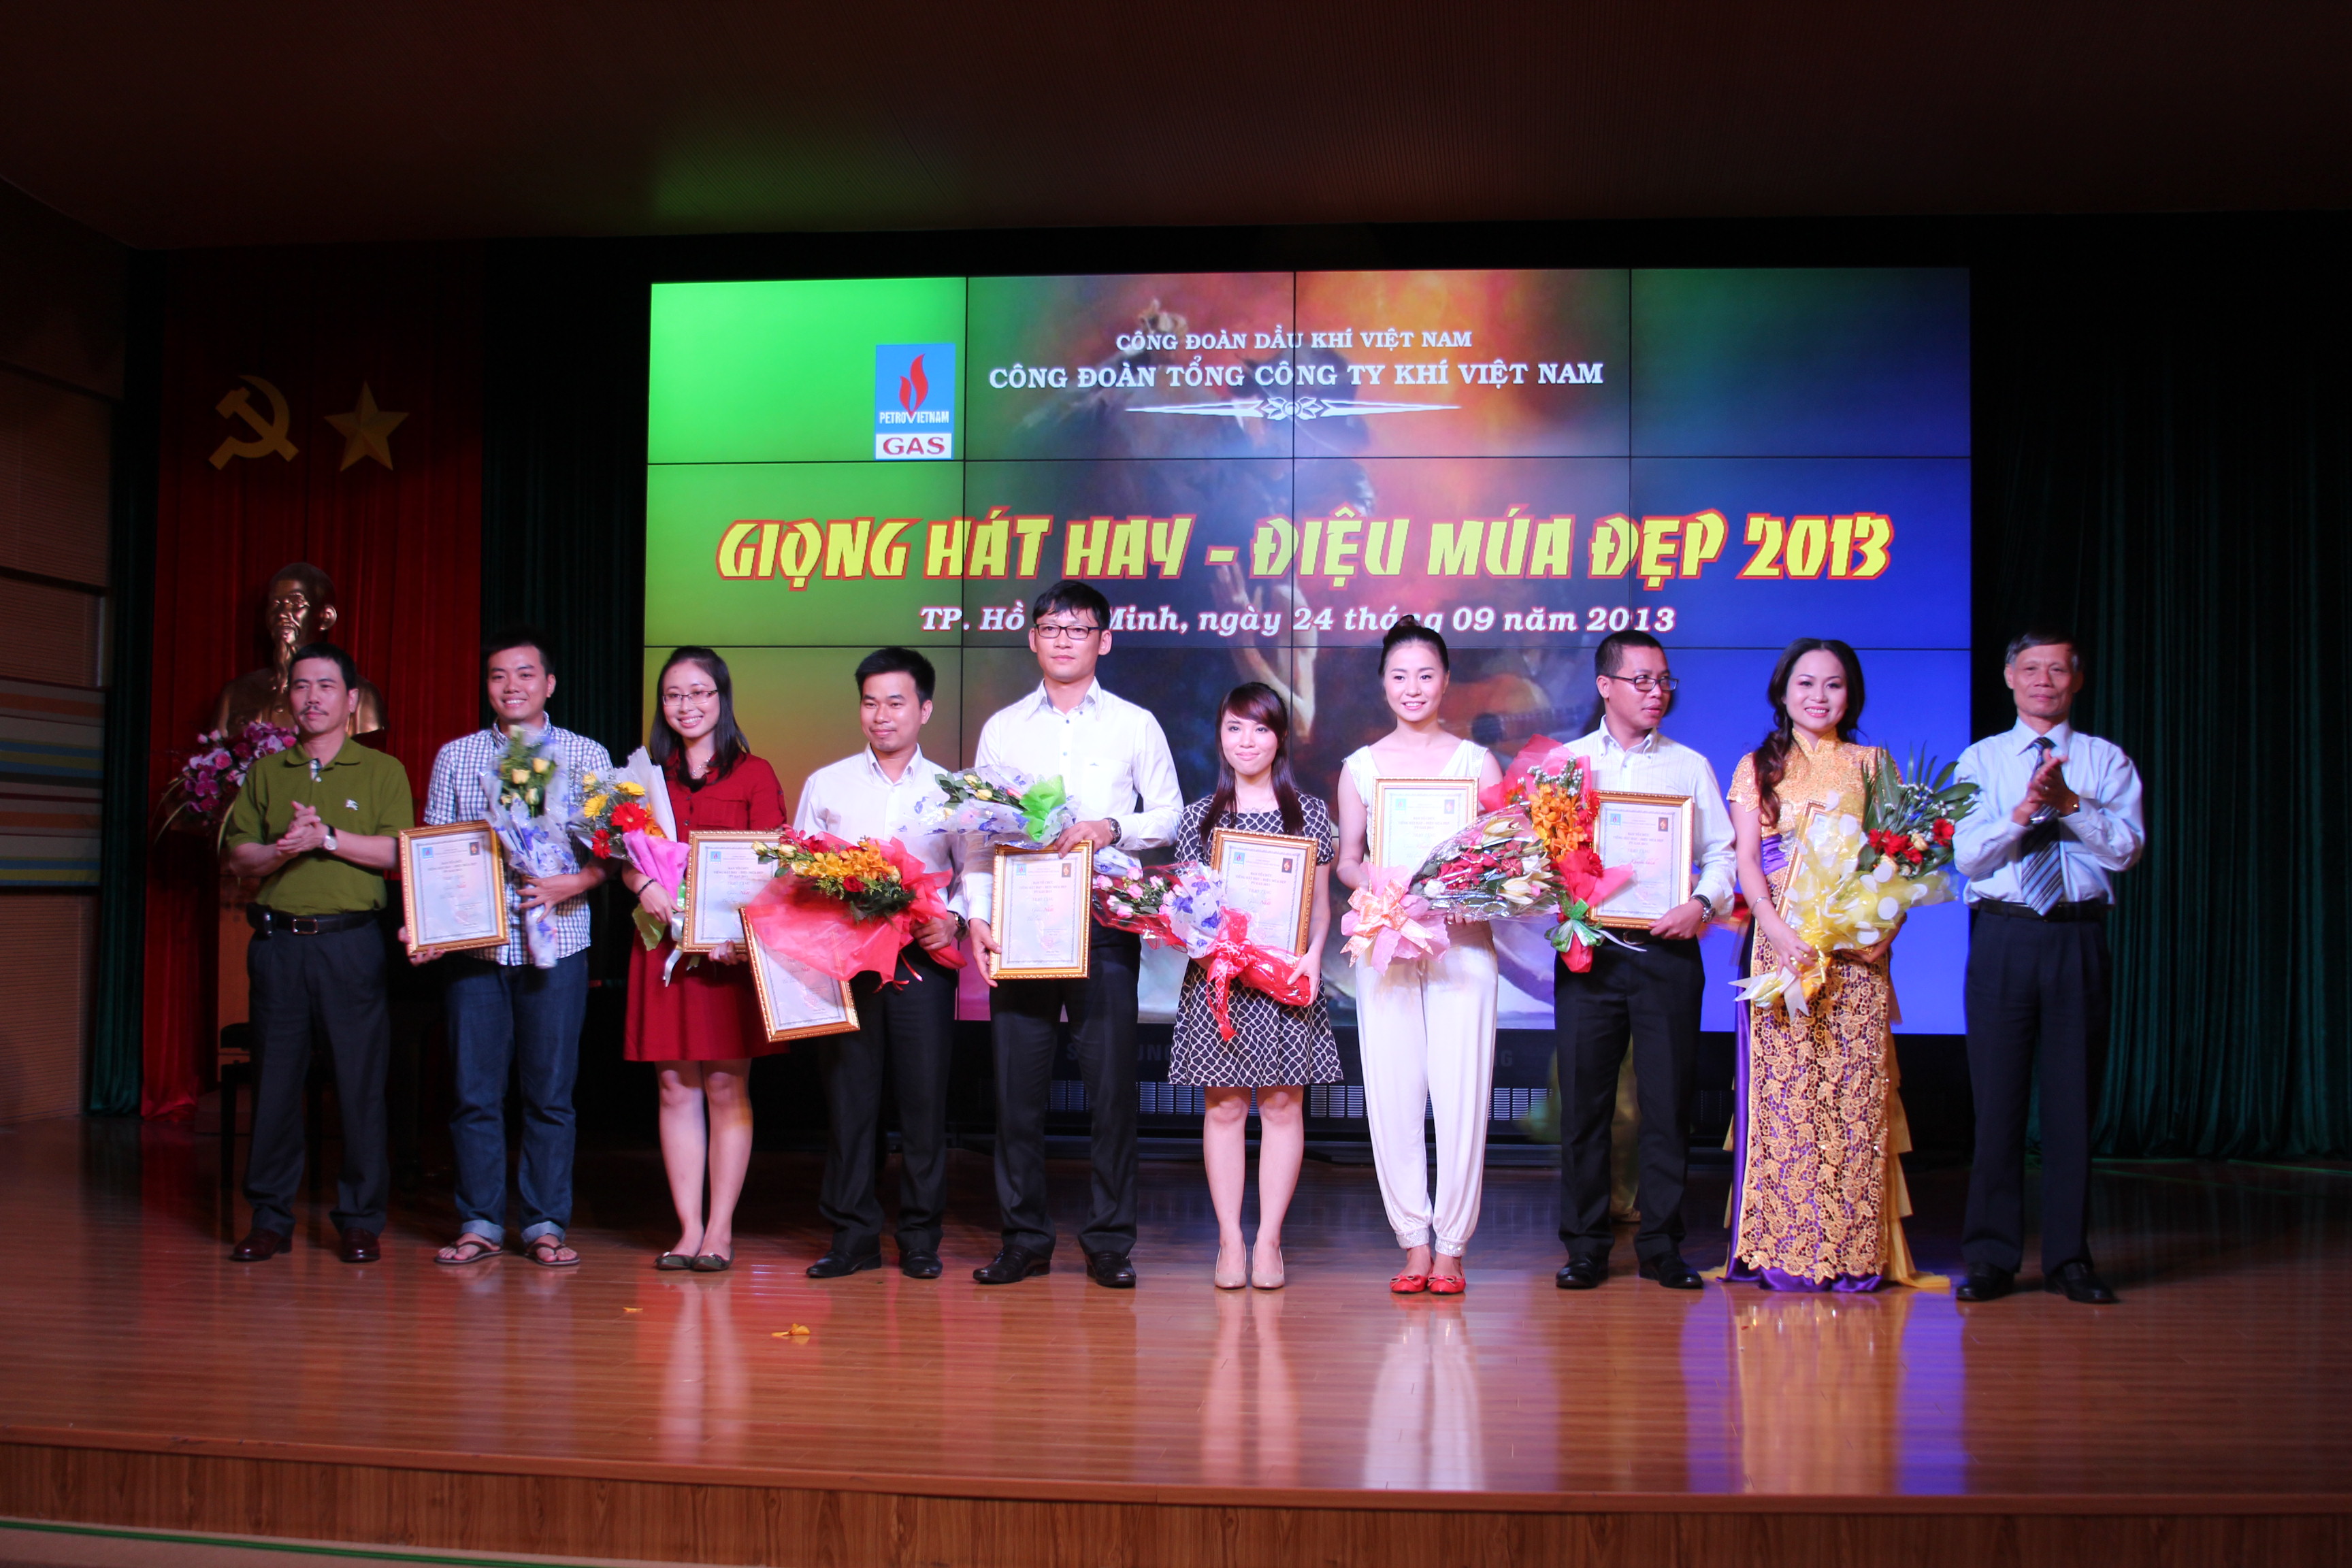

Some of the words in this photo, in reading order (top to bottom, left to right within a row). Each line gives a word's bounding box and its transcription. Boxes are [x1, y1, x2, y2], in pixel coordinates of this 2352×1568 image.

[1116, 331, 1178, 350] CÔNG
[1185, 329, 1247, 350] ĐOÀN
[1254, 325, 1303, 349] DẦU
[1311, 328, 1353, 348] KHÍ
[1360, 327, 1414, 352] VIỆT
[1421, 331, 1473, 348] NAM
[989, 363, 1068, 389] CÔNG
[1077, 362, 1156, 388] ĐOÀN
[1166, 355, 1245, 387] TỔNG
[1255, 361, 1338, 387] CÔNG
[1347, 365, 1386, 385] TY
[1394, 359, 1449, 385] KHÍ
[1458, 359, 1529, 389] VIỆT
[1537, 363, 1604, 385] NAM
[879, 410, 950, 425] PETROVIETNAM
[883, 436, 945, 455] GAS
[717, 519, 919, 590] GIỌNG
[924, 507, 1053, 578] HÁT
[1063, 515, 1195, 578] HAY
[1251, 504, 1413, 589] ĐIỆU
[1426, 505, 1574, 577] MÚA
[1588, 510, 1727, 589] ĐẸP
[1737, 513, 1893, 578] 2013
[921, 608, 969, 630] TP.
[981, 601, 1024, 630] Hồ
[1198, 604, 1281, 636] ngày
[1293, 608, 1333, 631] 24
[1345, 605, 1443, 633] thág
[1453, 608, 1494, 632] 09
[1503, 608, 1577, 632] năm
[1587, 608, 1676, 632] 2013
